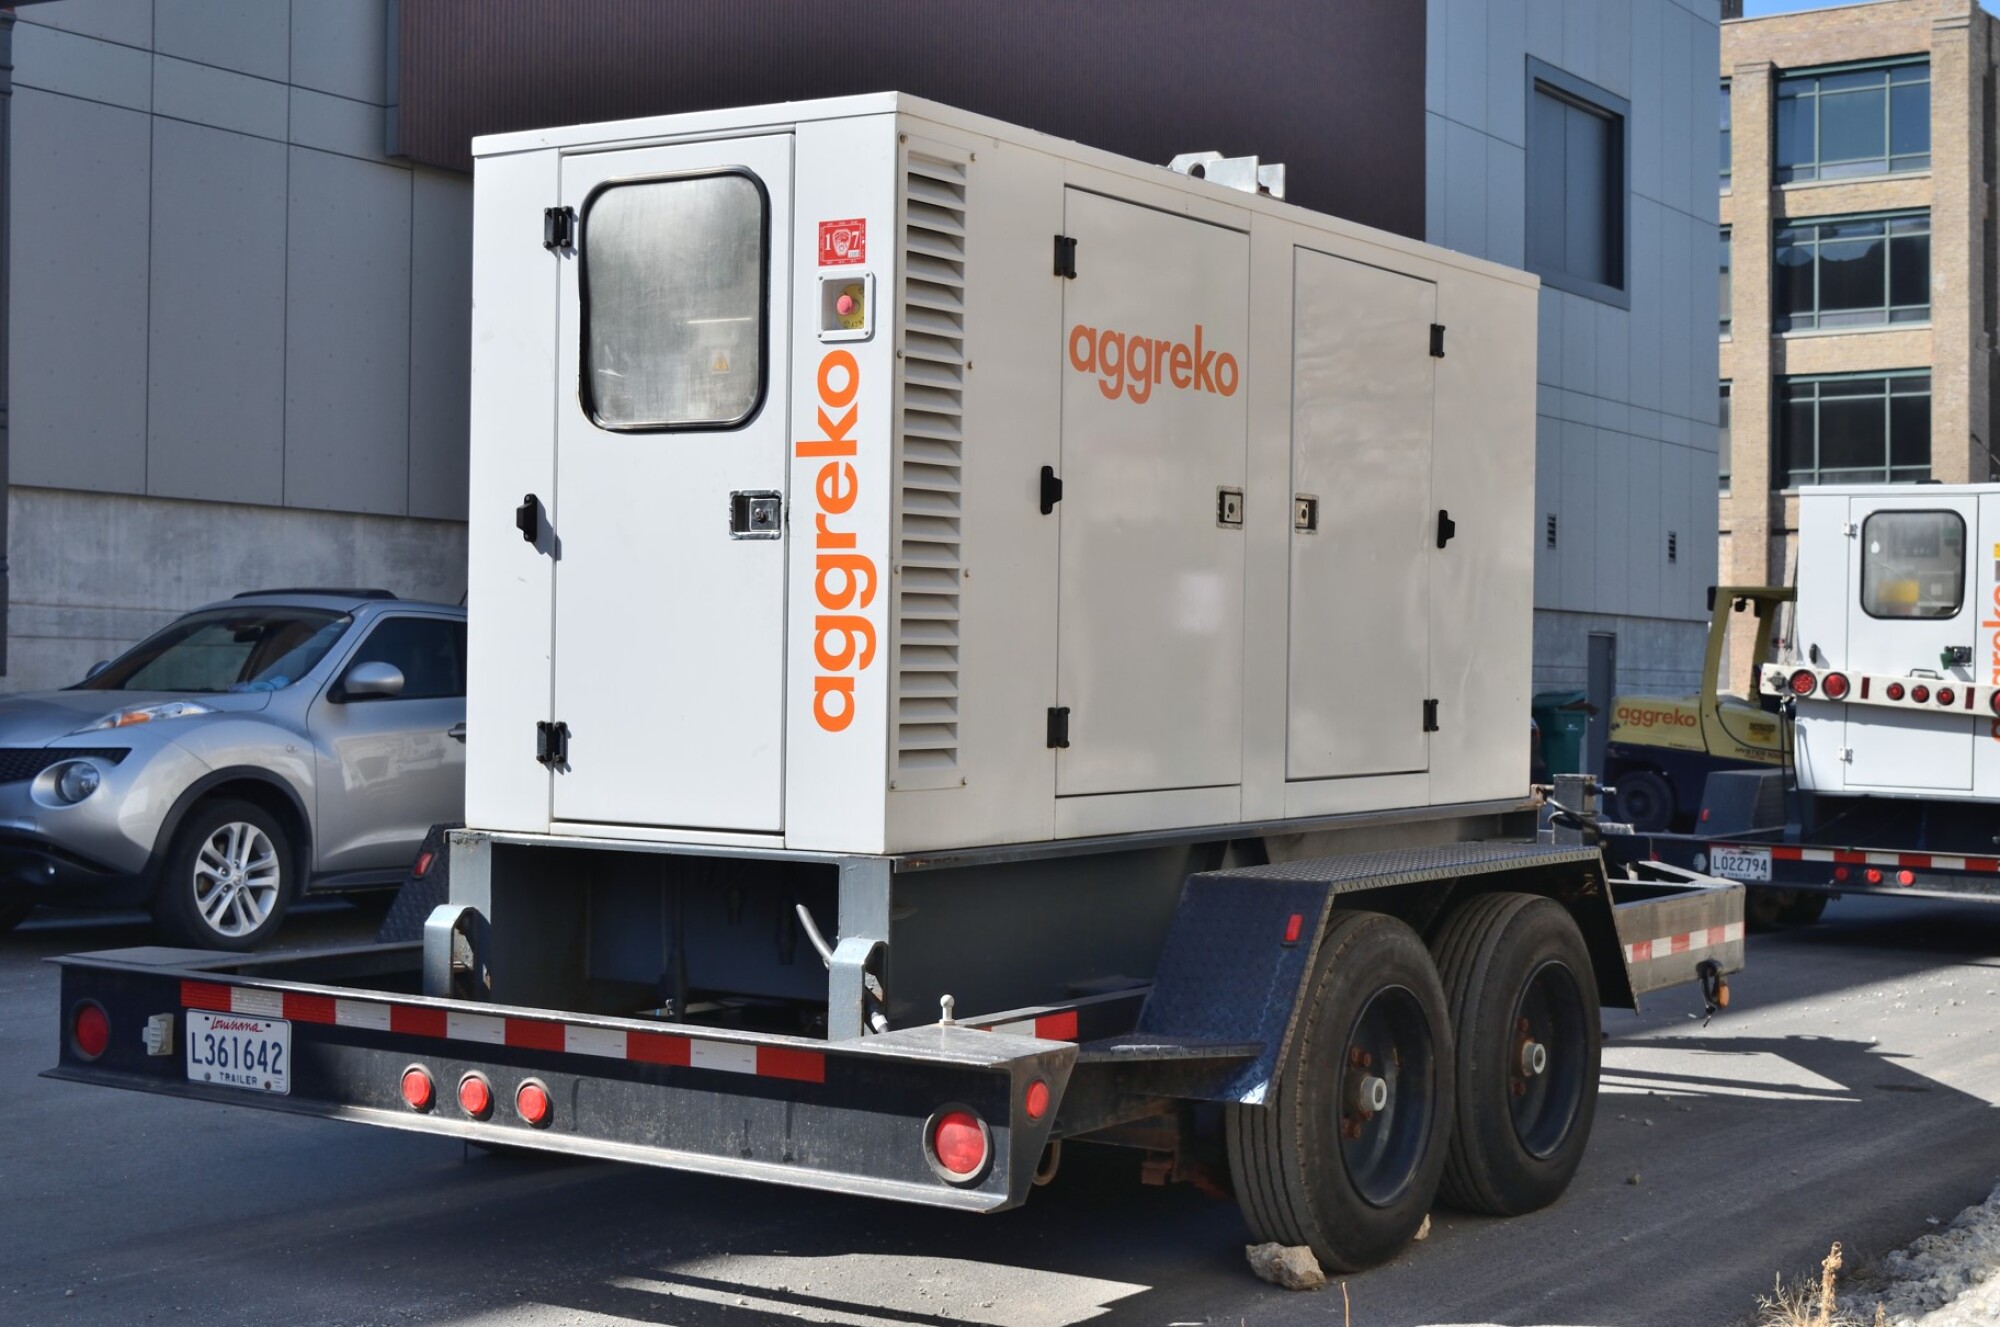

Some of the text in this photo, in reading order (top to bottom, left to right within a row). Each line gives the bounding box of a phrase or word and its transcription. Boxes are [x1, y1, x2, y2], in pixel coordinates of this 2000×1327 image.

[1069, 324, 1239, 405] aggreko
[796, 349, 878, 733] aggreko
[1617, 706, 1697, 728] aggreko
[1713, 855, 1768, 874] L022794
[210, 1016, 264, 1033] Louisiana
[191, 1031, 283, 1075] L361642
[219, 1071, 258, 1086] TRAILER
